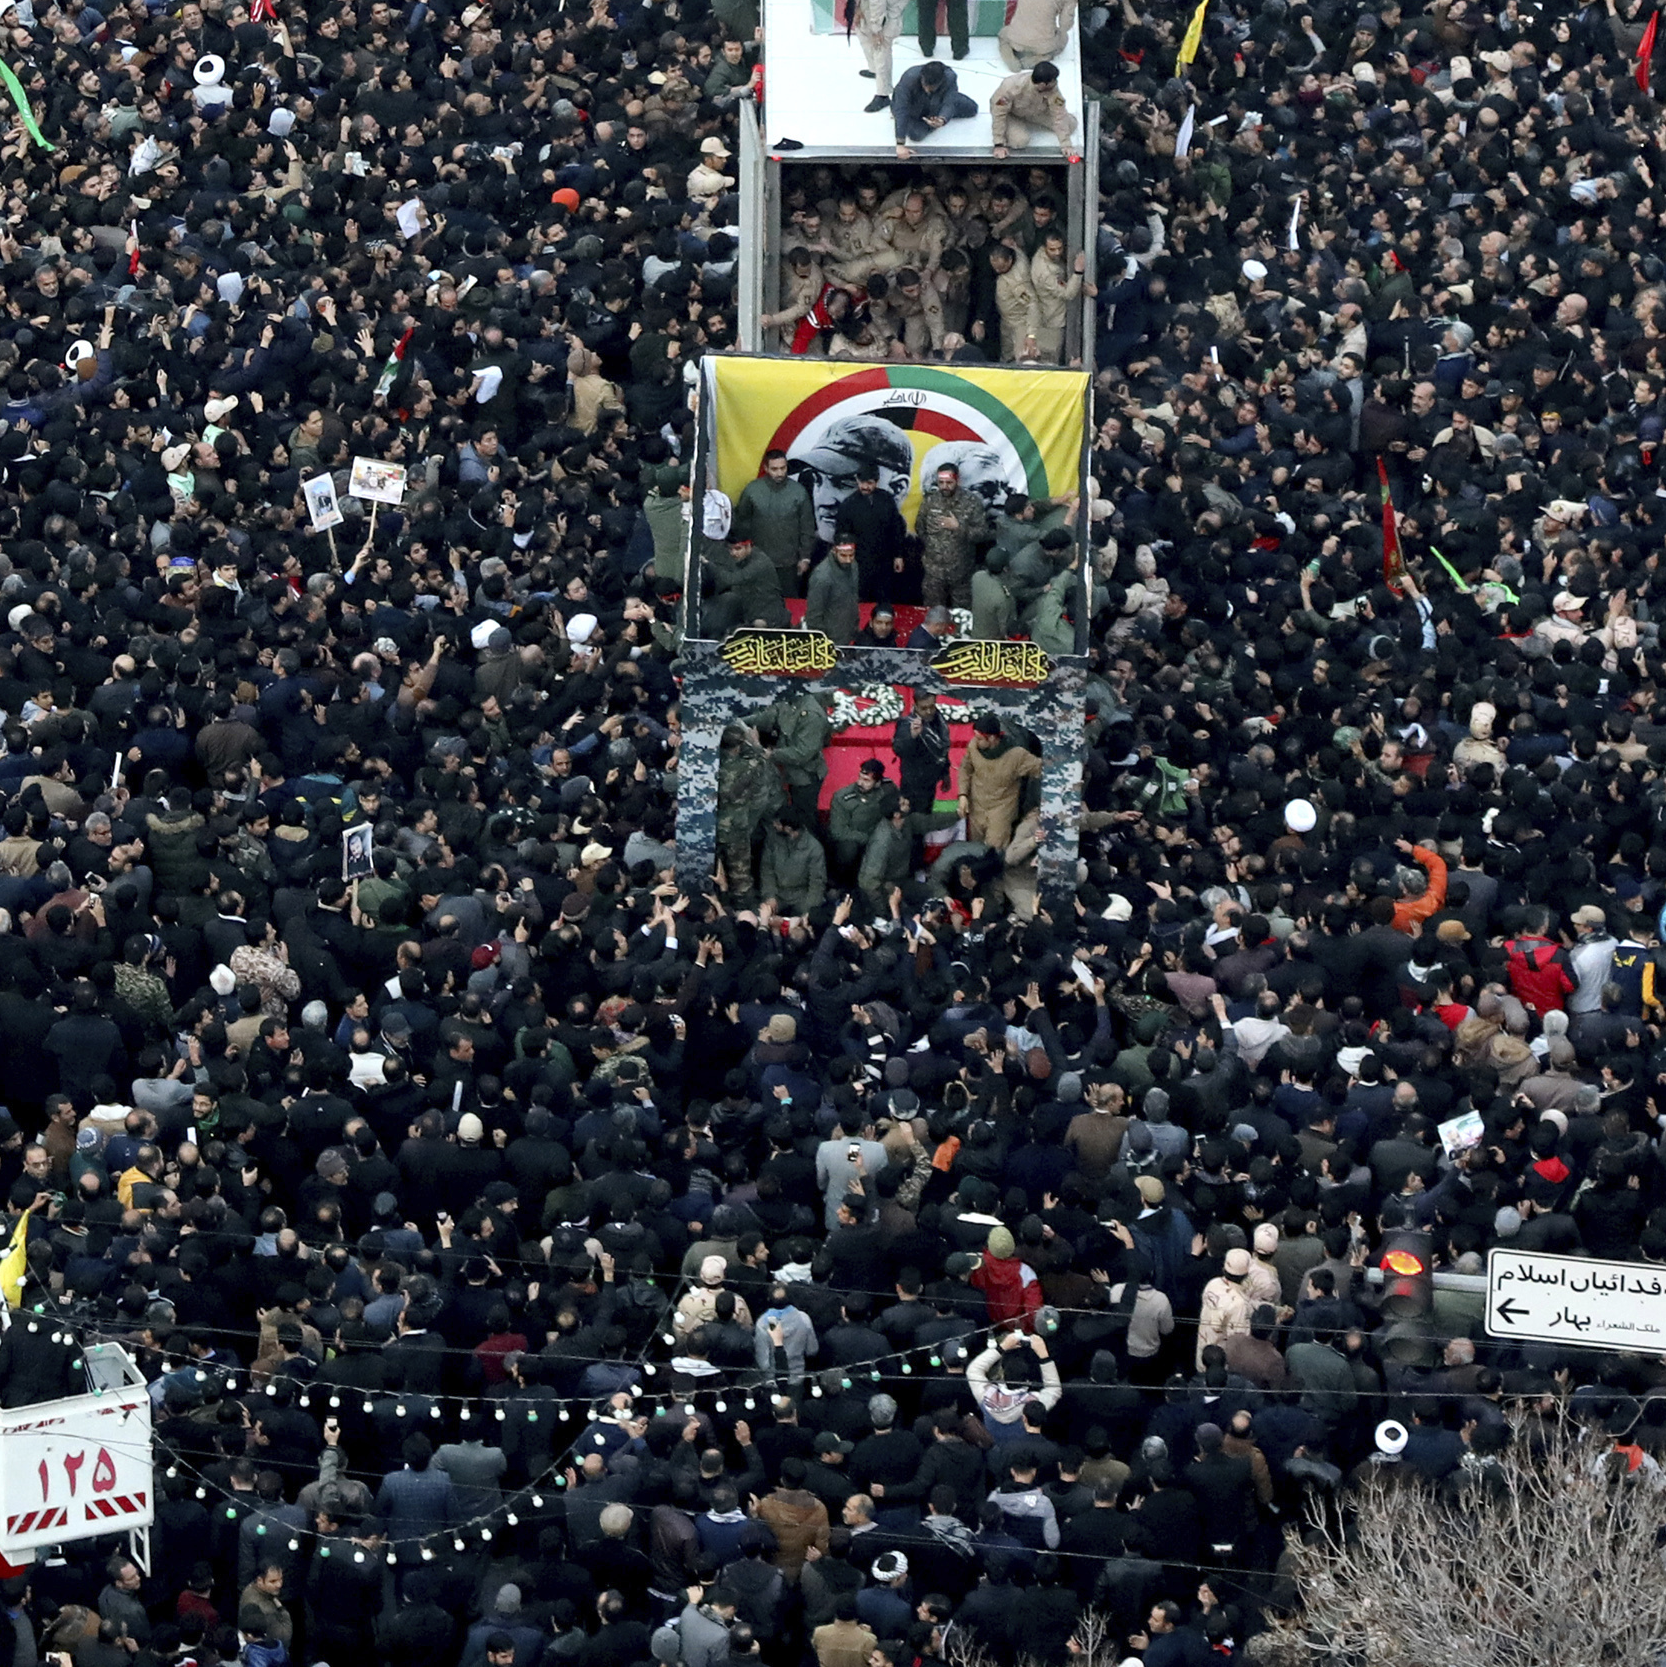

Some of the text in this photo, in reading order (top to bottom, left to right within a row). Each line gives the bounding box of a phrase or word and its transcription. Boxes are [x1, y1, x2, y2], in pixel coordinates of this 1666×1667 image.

[1497, 1264, 1661, 1296] فدائیان اسلام
[1549, 1306, 1591, 1332] بهار
[38, 1447, 117, 1503] ۱۲۵
